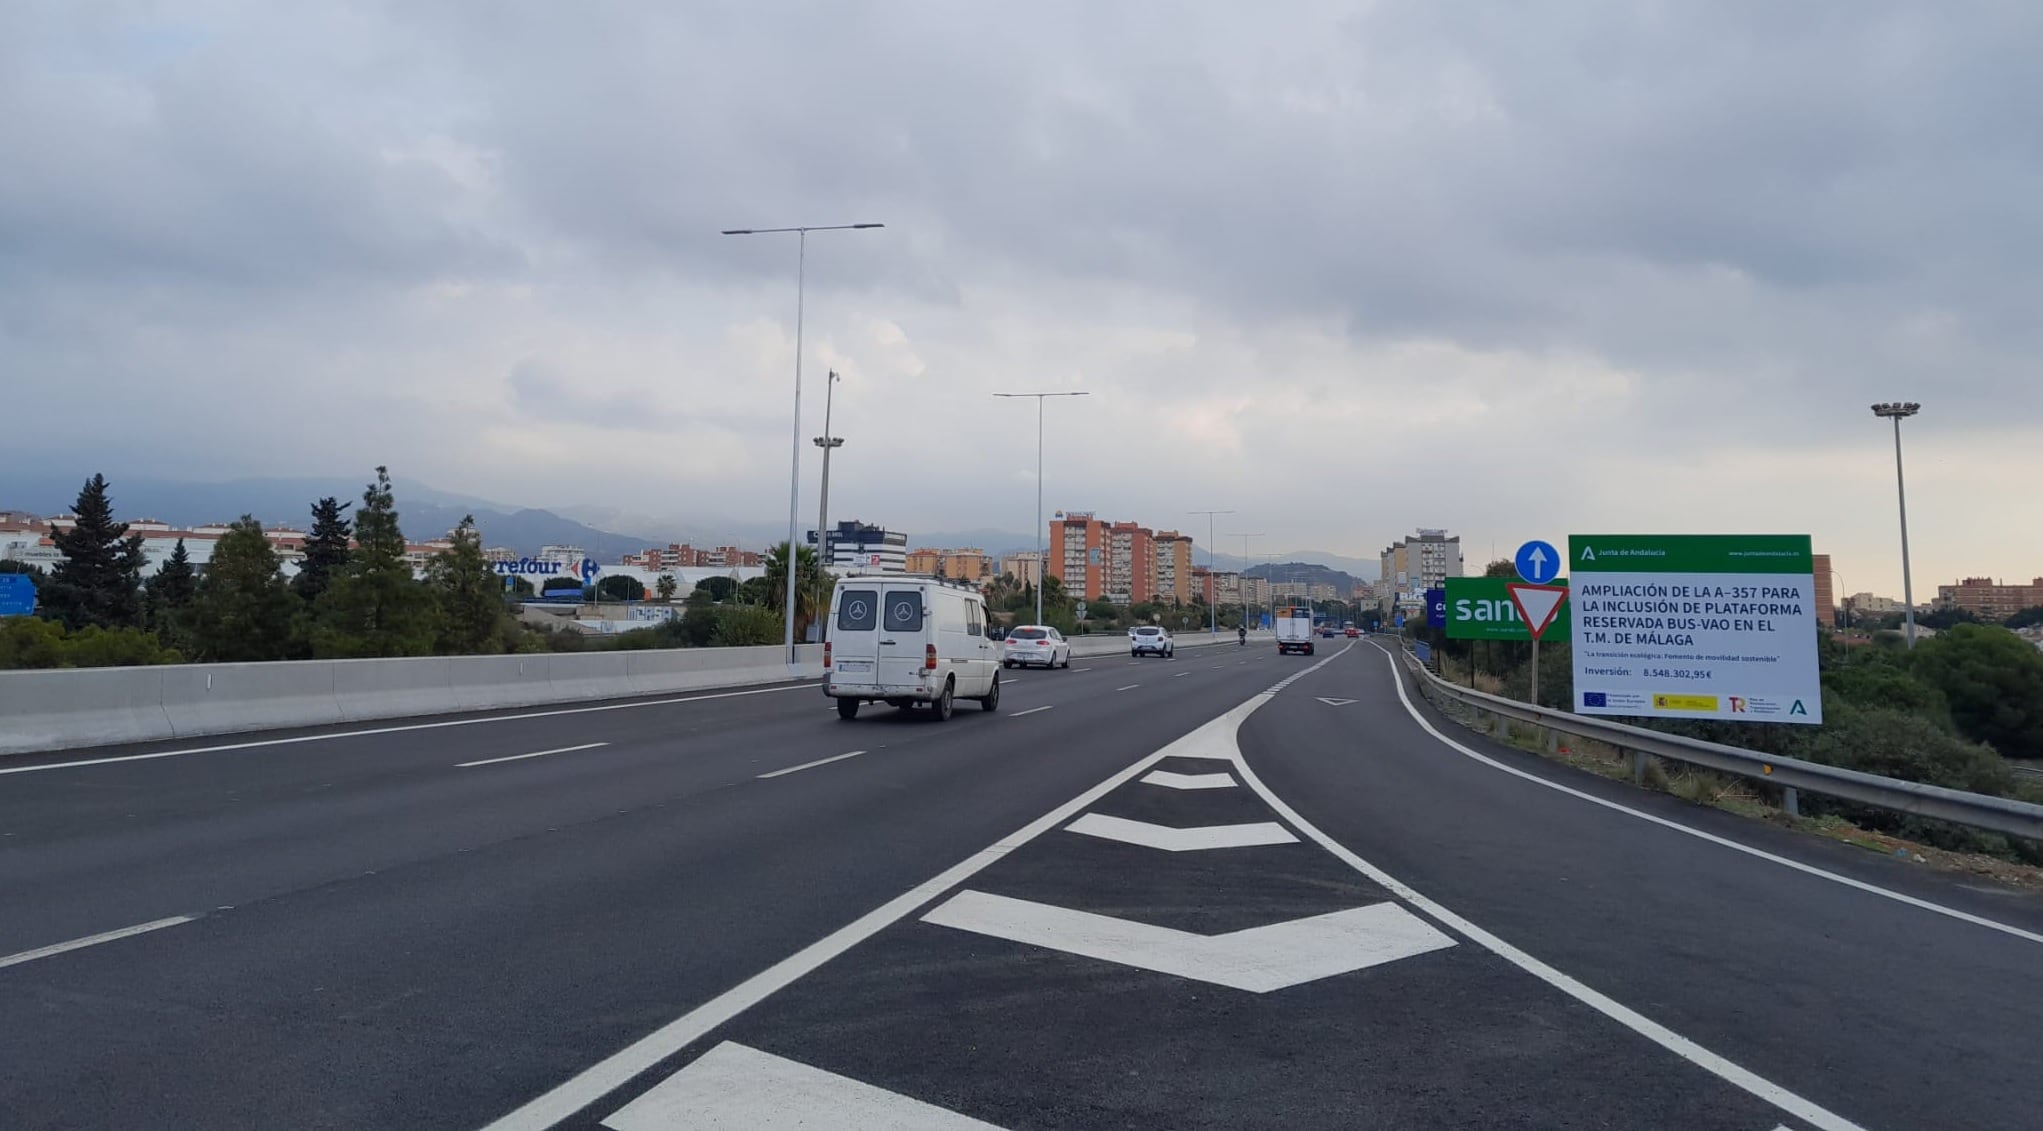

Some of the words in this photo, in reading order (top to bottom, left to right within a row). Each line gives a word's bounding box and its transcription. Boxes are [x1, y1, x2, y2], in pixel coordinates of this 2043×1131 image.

[1582, 583, 1667, 597] AMPLIACIÓN
[1672, 586, 1690, 597] DE
[1694, 586, 1711, 598] LA
[1762, 587, 1800, 599] PARA
[1583, 600, 1599, 611] LA
[1603, 599, 1678, 613] INCLUSIÓN
[1683, 602, 1701, 613] DE
[1705, 602, 1802, 615] PLATAFORMA
[1583, 616, 1664, 629] RESERVADA
[1668, 618, 1730, 630] BUS-VAO
[1734, 619, 1753, 631] EN
[1758, 620, 1775, 631] EL
[1584, 632, 1611, 643] T.M.
[1615, 633, 1632, 643] DE
[1637, 631, 1694, 645] MÁLAGA
[1585, 666, 1632, 676] Inversión:
